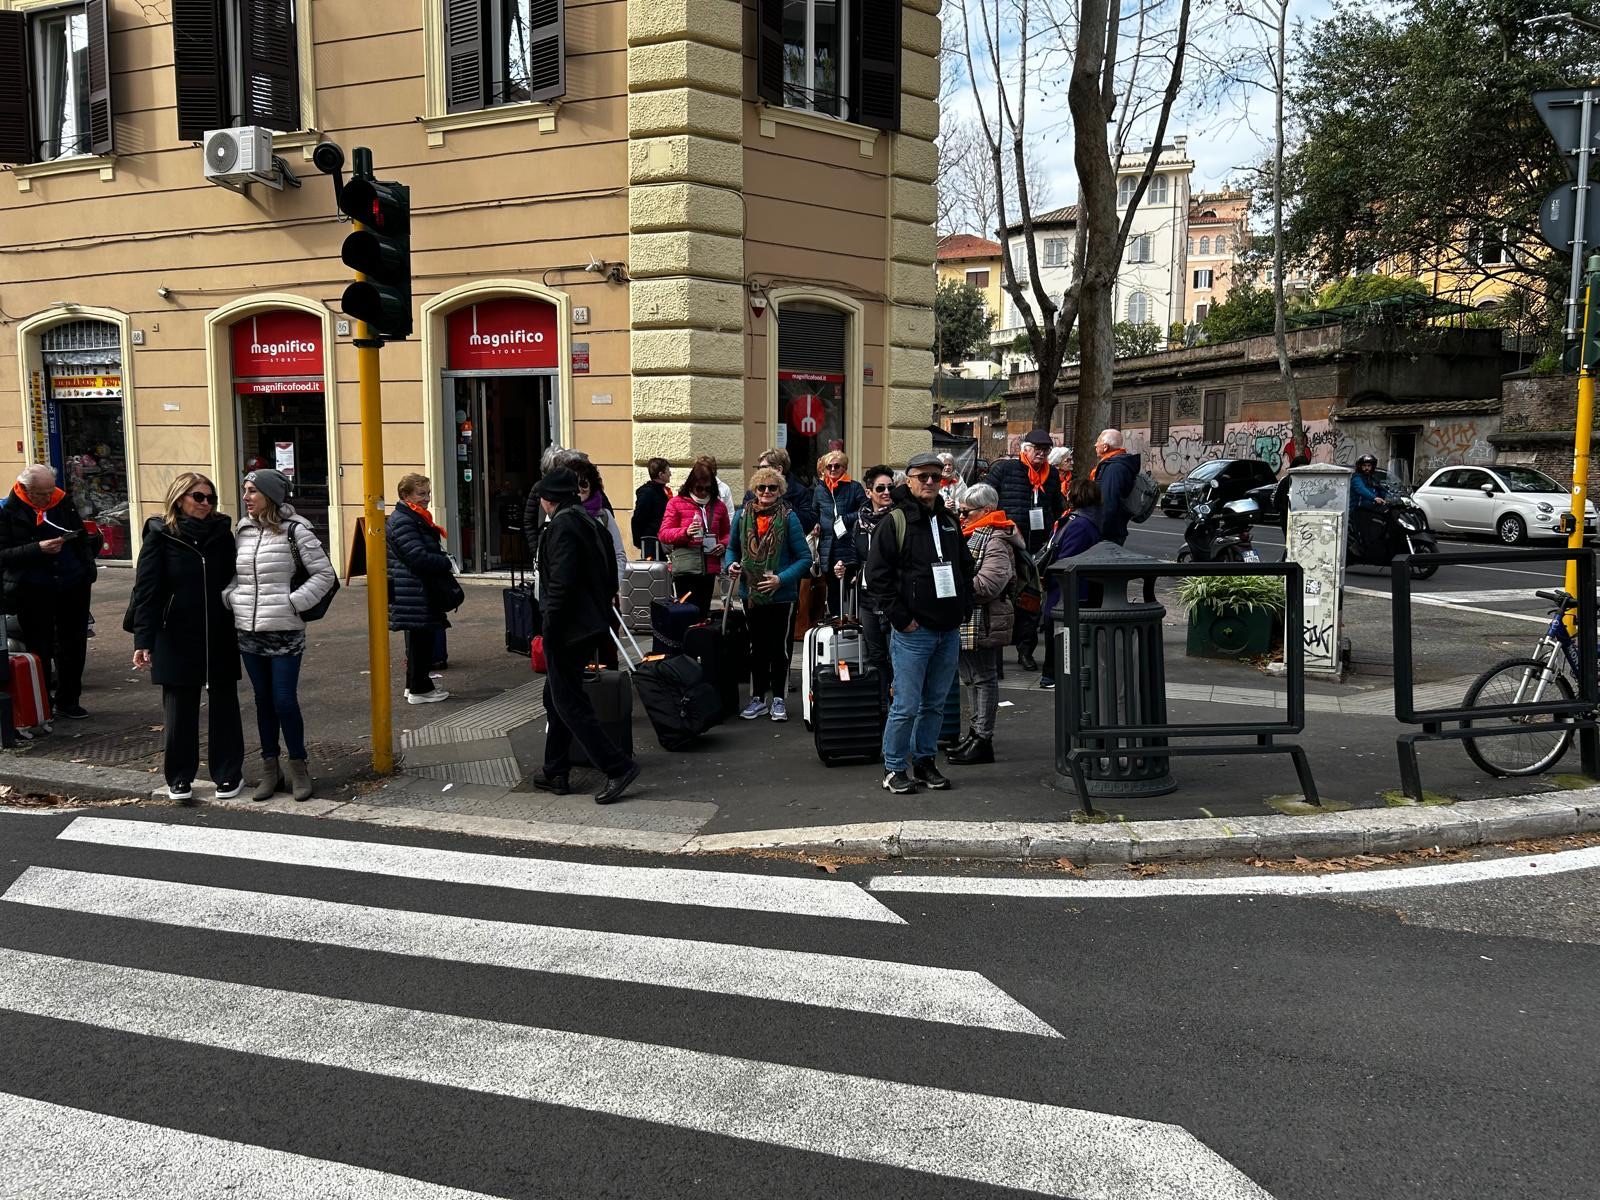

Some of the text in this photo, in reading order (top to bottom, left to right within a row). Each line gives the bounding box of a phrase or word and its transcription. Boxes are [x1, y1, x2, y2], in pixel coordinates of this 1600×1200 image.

[575, 309, 585, 320] 84
[469, 329, 544, 347] magnifico
[251, 340, 315, 356] magnifico
[253, 382, 320, 393] magnificofood.it
